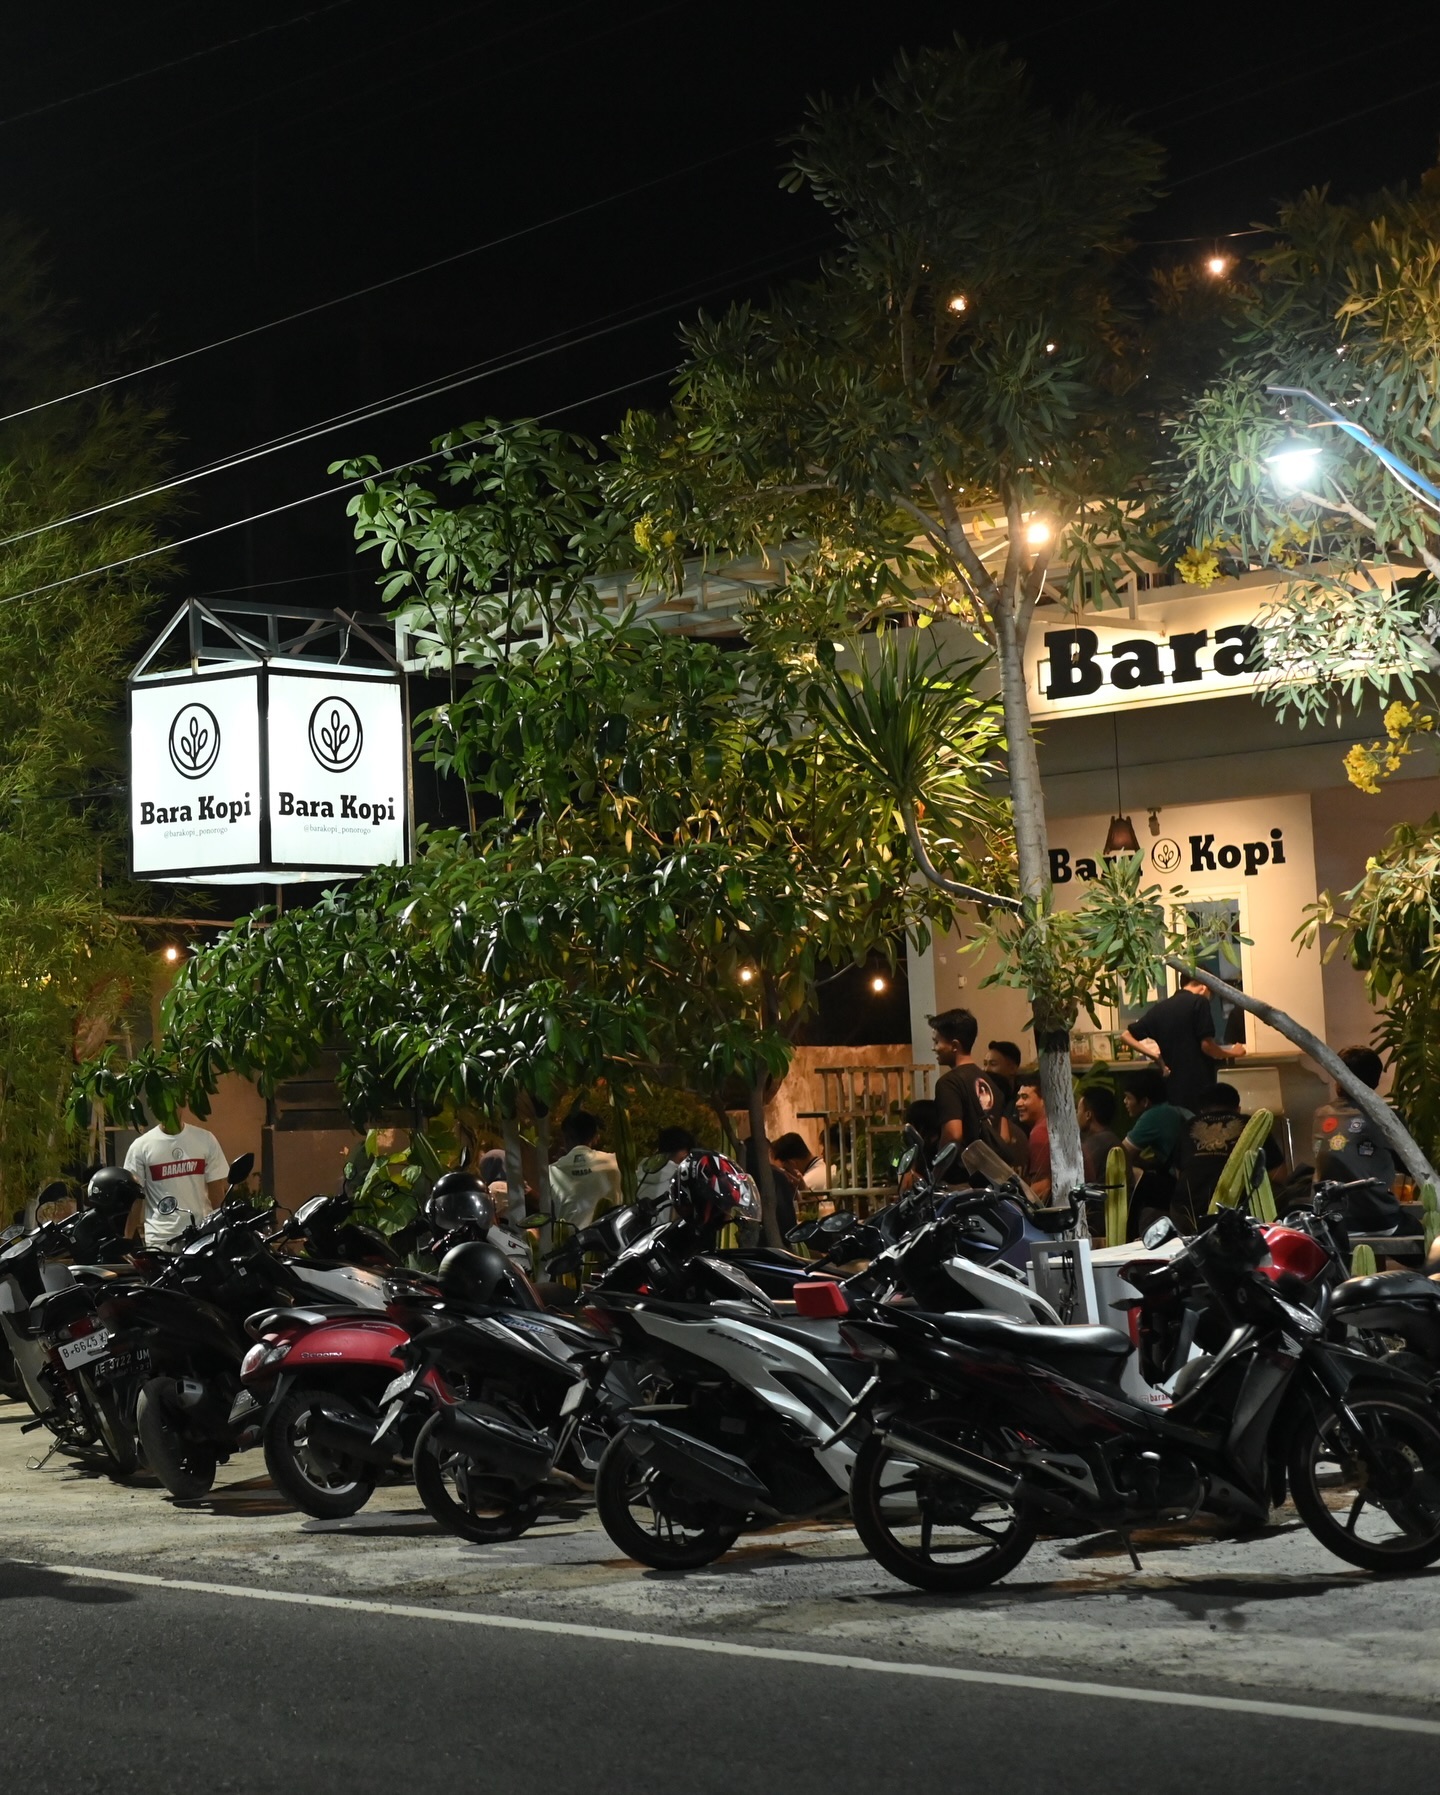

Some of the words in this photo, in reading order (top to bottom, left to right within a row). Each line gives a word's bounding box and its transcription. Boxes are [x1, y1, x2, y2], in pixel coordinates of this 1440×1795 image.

[1044, 624, 1270, 700] Bara
[140, 801, 192, 825] Bara
[198, 792, 252, 824] Kopi
[279, 791, 334, 818] Bara
[340, 794, 395, 826] Kopi
[163, 827, 228, 839] @barakopi_ponorogo
[303, 824, 371, 836] @barakopi_ponorogo
[1048, 848, 1143, 884] Bar
[1188, 828, 1286, 876] Kopi
[73, 1335, 98, 1354] 6645
[109, 1353, 132, 1370] 3722
[136, 1348, 150, 1361] UM
